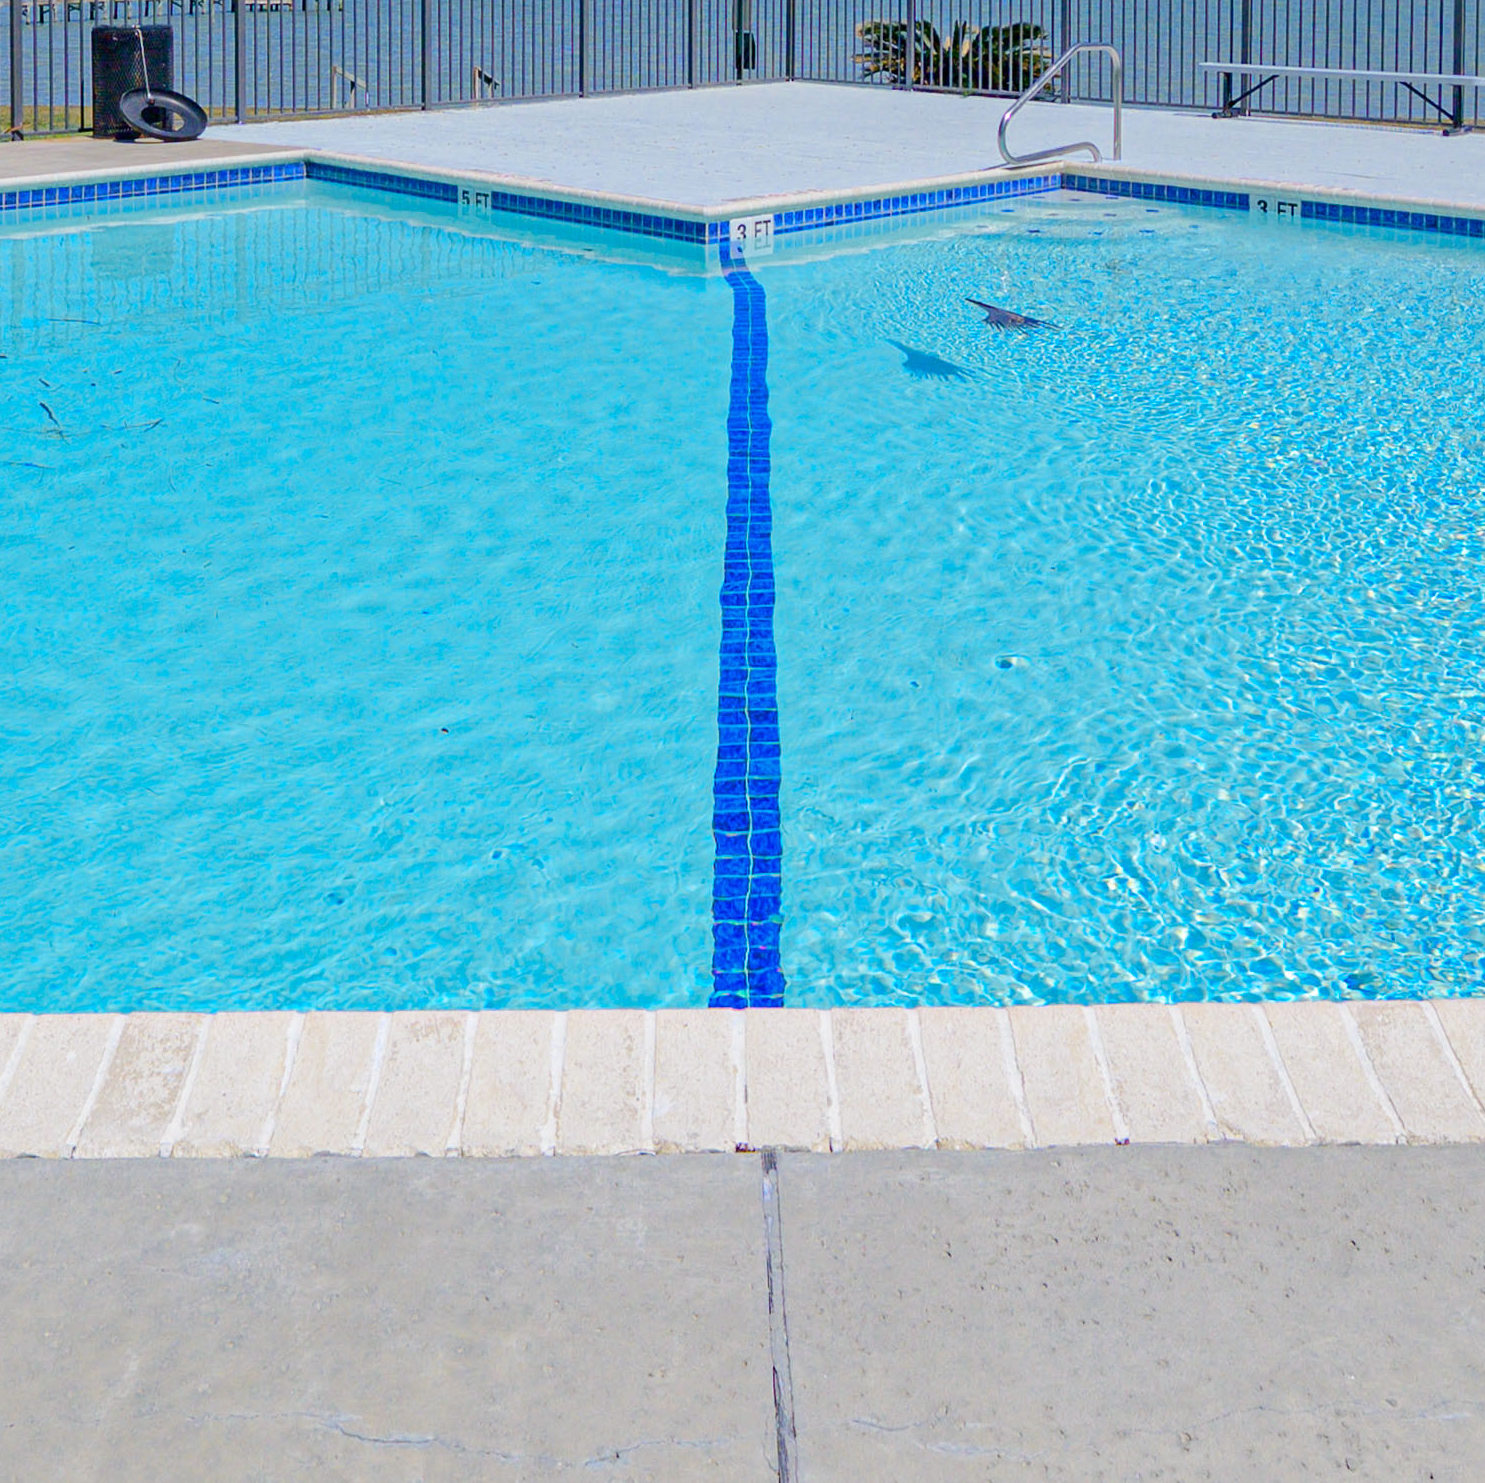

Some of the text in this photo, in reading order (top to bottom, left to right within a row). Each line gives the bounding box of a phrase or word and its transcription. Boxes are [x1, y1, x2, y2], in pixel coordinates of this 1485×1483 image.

[462, 190, 490, 208] 5 FT
[1277, 201, 1298, 216] FT
[737, 219, 771, 239] 3 FT
